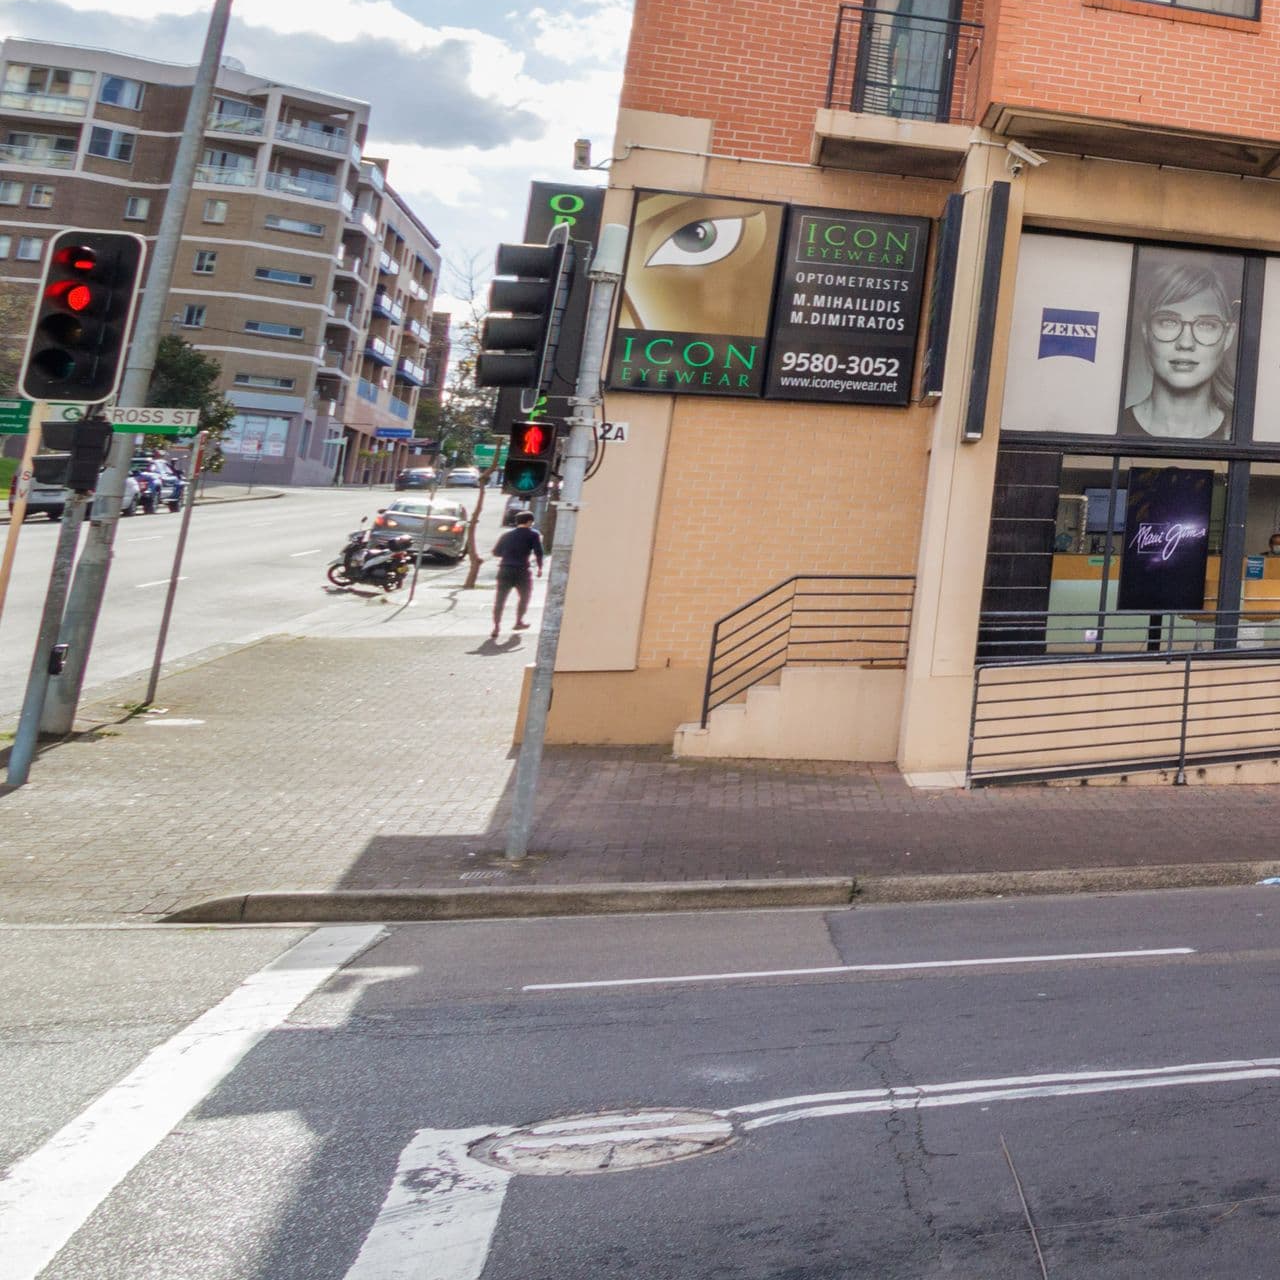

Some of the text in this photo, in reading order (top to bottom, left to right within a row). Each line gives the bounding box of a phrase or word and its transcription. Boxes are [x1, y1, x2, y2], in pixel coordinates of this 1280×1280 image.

[807, 223, 911, 252] ICON
[806, 246, 905, 265] EYEWEAR
[795, 272, 909, 292] OPTOMETRISTS
[793, 293, 901, 314] M.MIHAILIDIS
[790, 311, 905, 332] M.DIMITRATOS
[1042, 322, 1096, 338] ZEISS
[621, 337, 758, 371] ICON
[780, 351, 899, 378] 9580-3052
[621, 367, 751, 388] EYEWEAR
[780, 375, 898, 394] www.iconeyewear.net
[172, 410, 197, 425] ST
[599, 422, 625, 441] 2A
[1129, 525, 1163, 549] Maui
